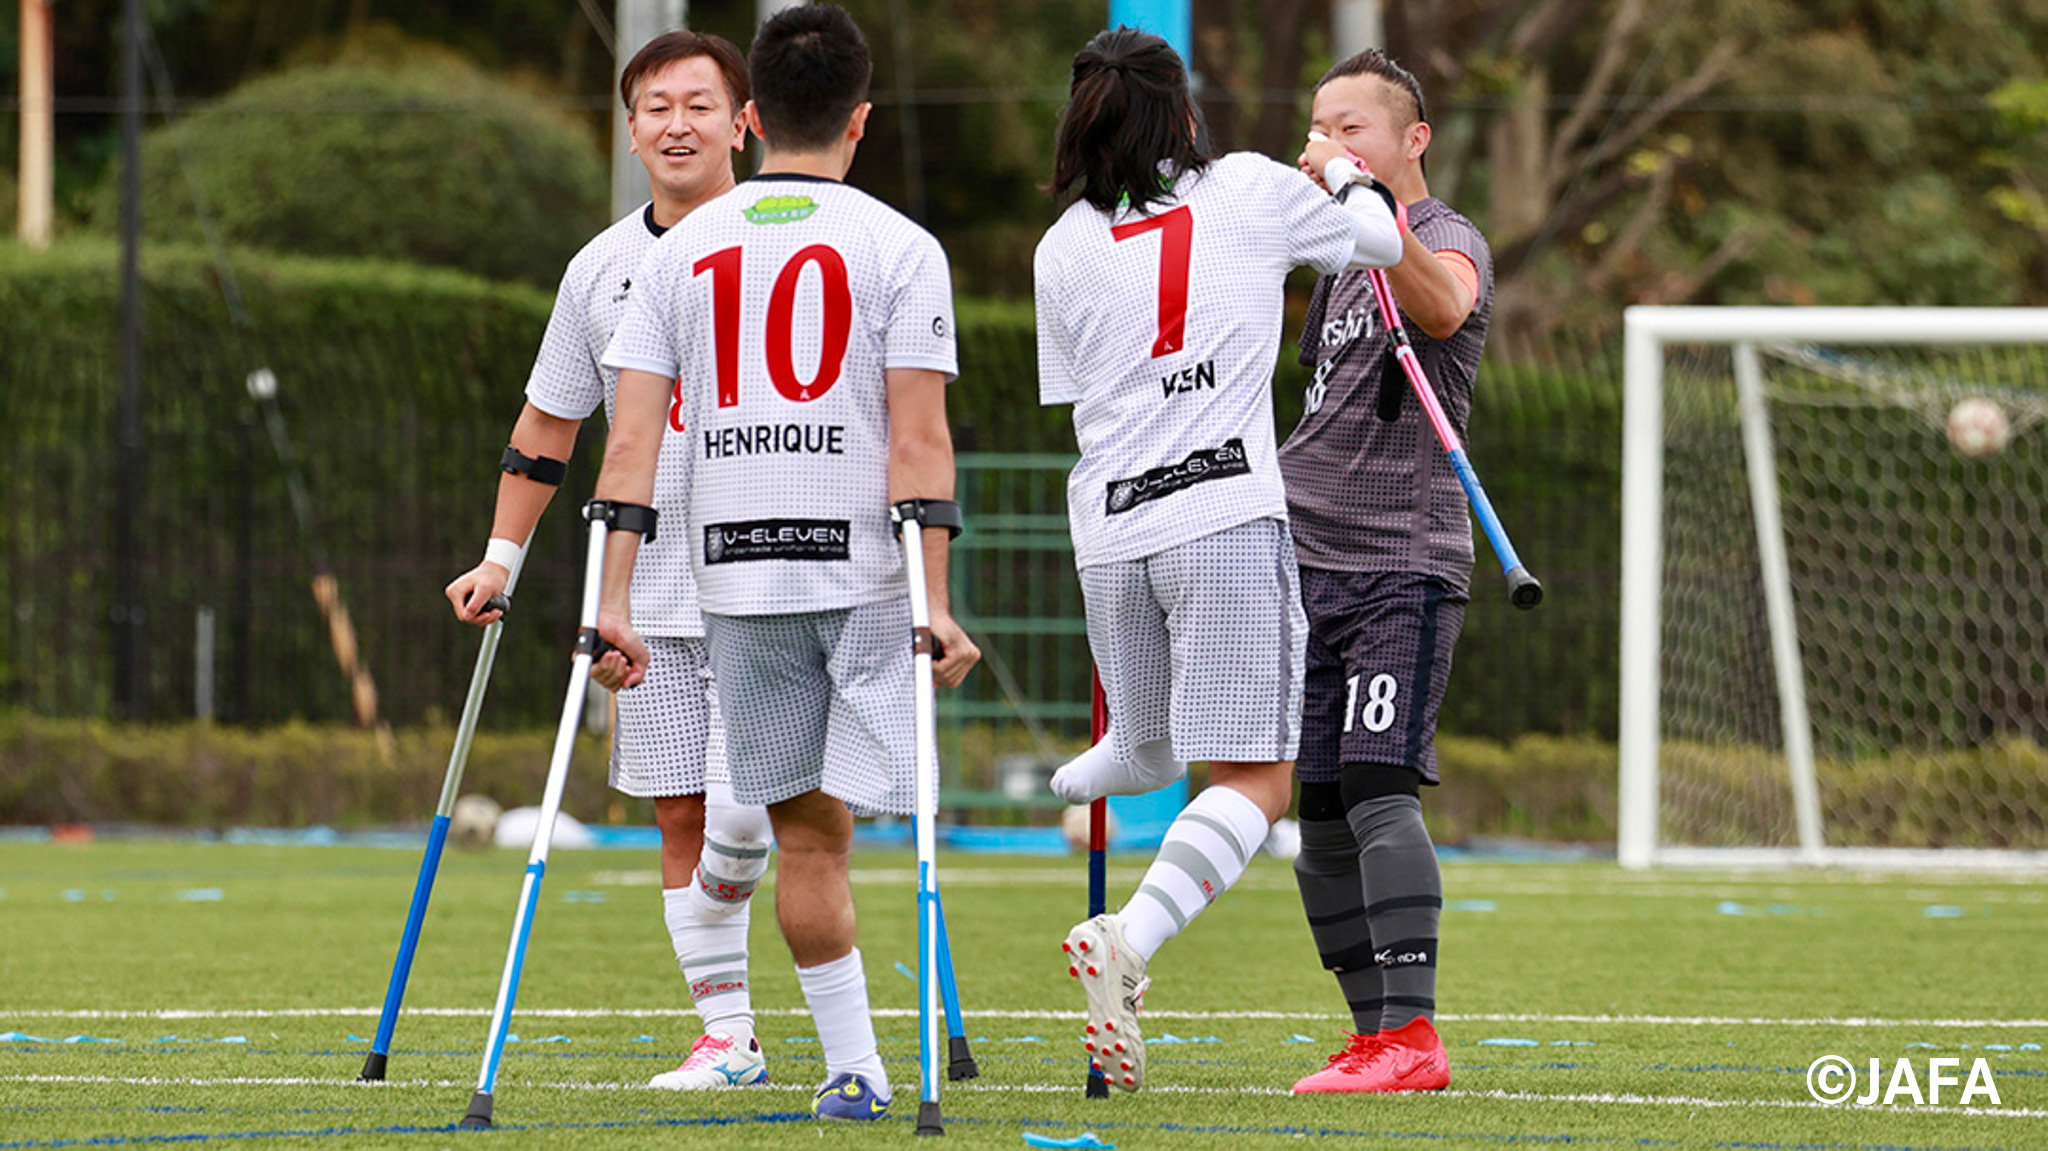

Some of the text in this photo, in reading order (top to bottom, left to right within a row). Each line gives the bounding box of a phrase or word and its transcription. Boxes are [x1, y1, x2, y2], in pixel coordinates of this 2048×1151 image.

[1111, 204, 1193, 359] 7
[693, 243, 852, 408] 10
[704, 424, 845, 459] HENRIQUE
[723, 527, 845, 545] V-ELEVEN
[1343, 672, 1398, 733] 18
